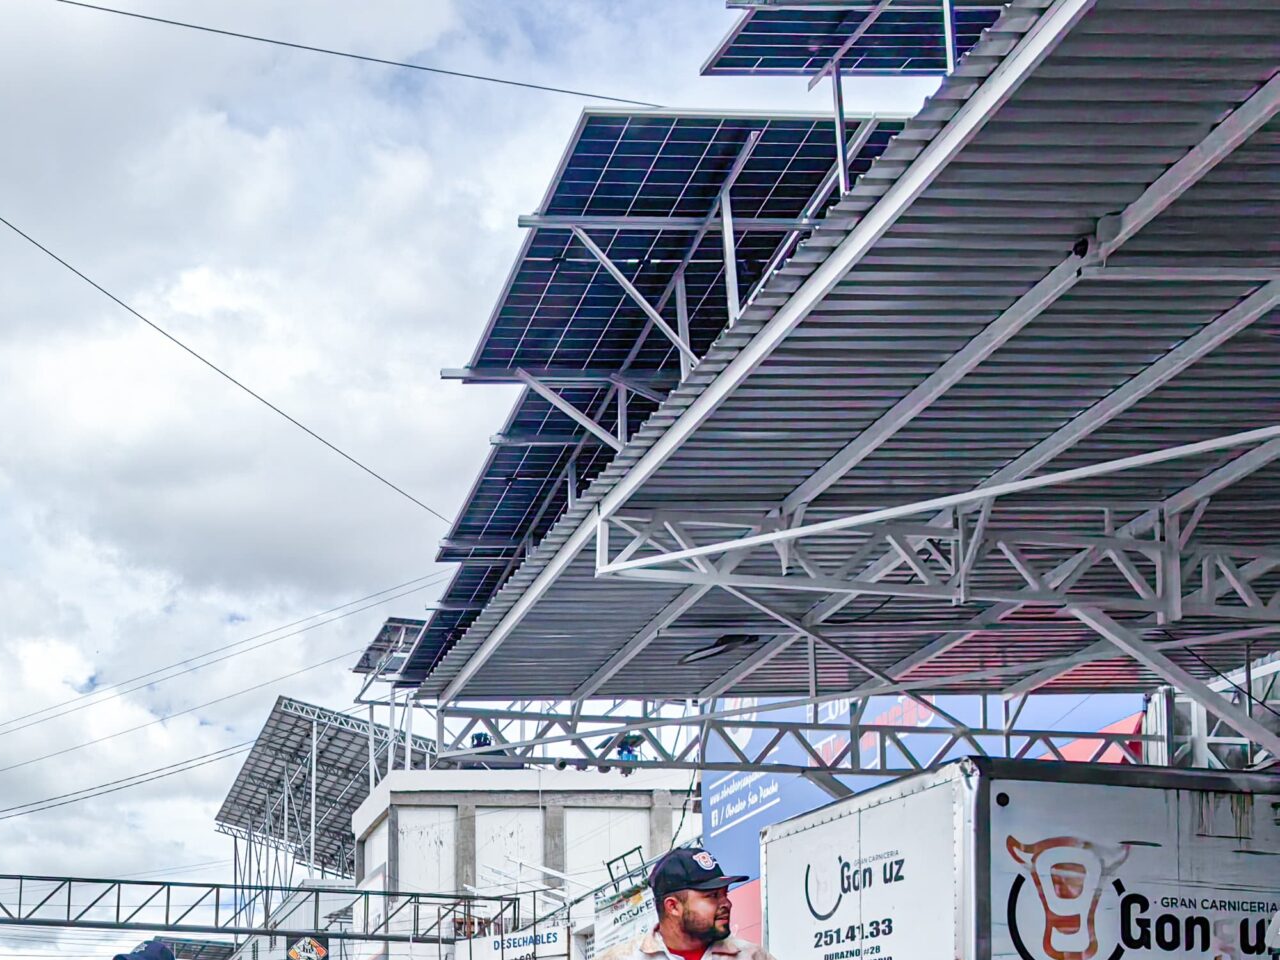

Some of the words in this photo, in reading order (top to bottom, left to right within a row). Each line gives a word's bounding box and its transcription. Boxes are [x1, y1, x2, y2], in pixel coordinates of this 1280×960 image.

[868, 849, 900, 863] CARNICERIA
[1160, 896, 1197, 910] GRAN
[1200, 898, 1279, 914] CARNICERIA
[493, 932, 558, 951] DESECHABLES
[813, 918, 893, 948] 251.41.33
[863, 945, 881, 955] #28
